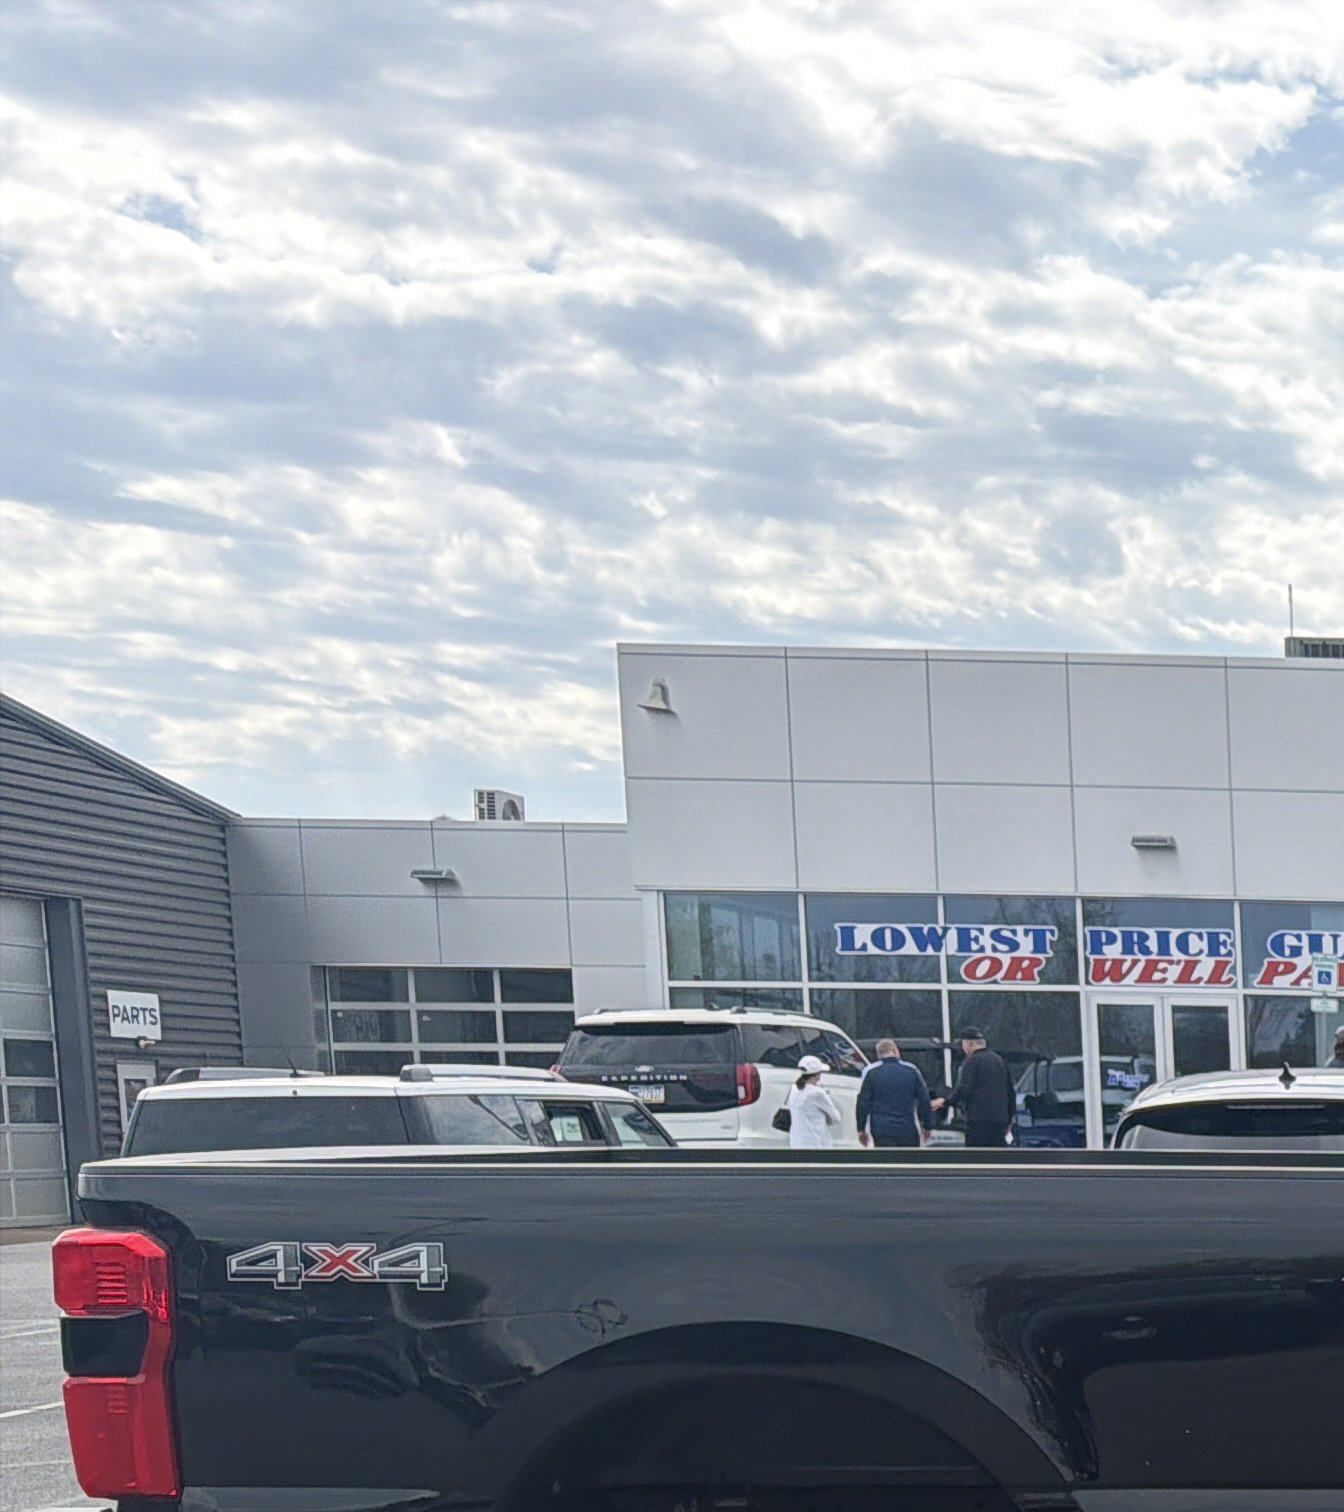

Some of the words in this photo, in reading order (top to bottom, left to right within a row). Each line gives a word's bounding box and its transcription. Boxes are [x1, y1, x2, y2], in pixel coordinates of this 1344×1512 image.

[837, 925, 1056, 955] LOWEST
[1086, 929, 1233, 958] PRICE
[963, 956, 1043, 982] OR
[111, 1004, 158, 1026] PARTS
